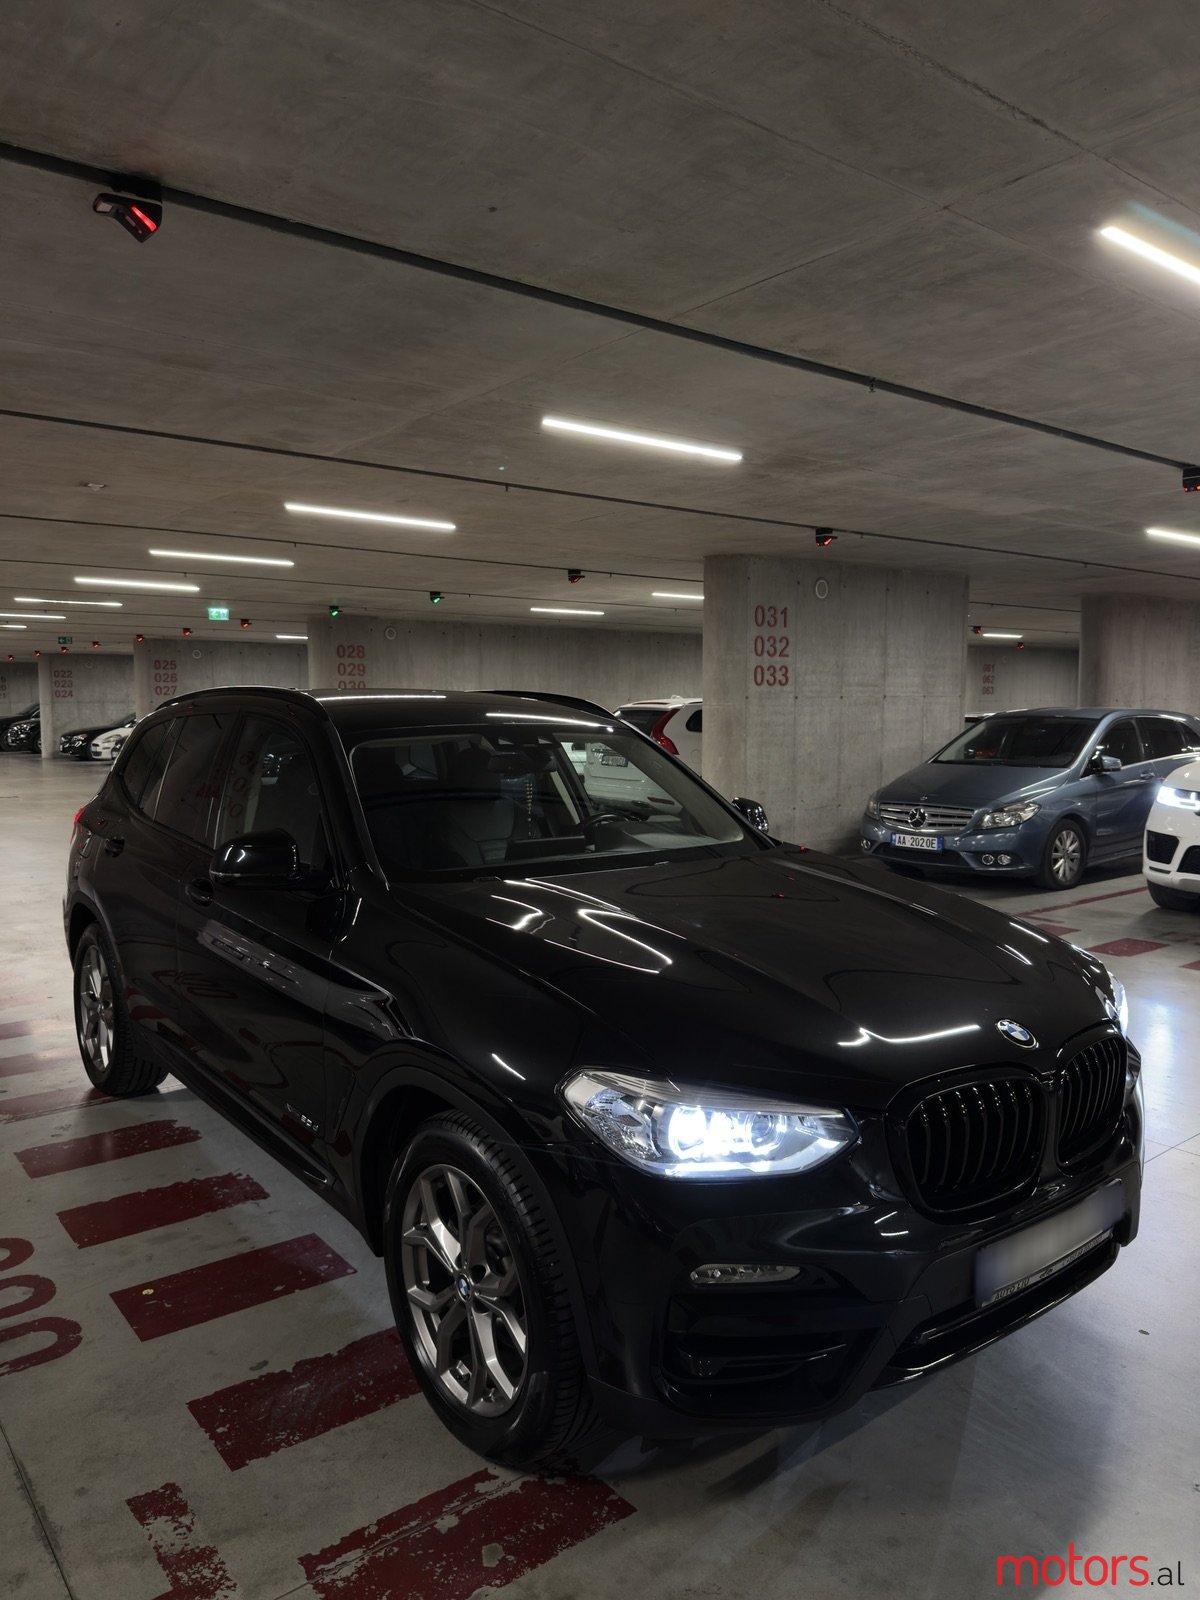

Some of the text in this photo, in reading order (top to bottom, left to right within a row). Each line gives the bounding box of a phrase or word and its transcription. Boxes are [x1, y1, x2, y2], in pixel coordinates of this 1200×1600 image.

[754, 604, 788, 628] 031
[336, 644, 366, 659] 028
[754, 635, 790, 658] 032
[153, 659, 178, 671] 025
[337, 662, 366, 677] 029
[154, 672, 178, 683] 026
[753, 665, 790, 687] 033
[154, 685, 178, 696] 027
[896, 835, 907, 846] AA
